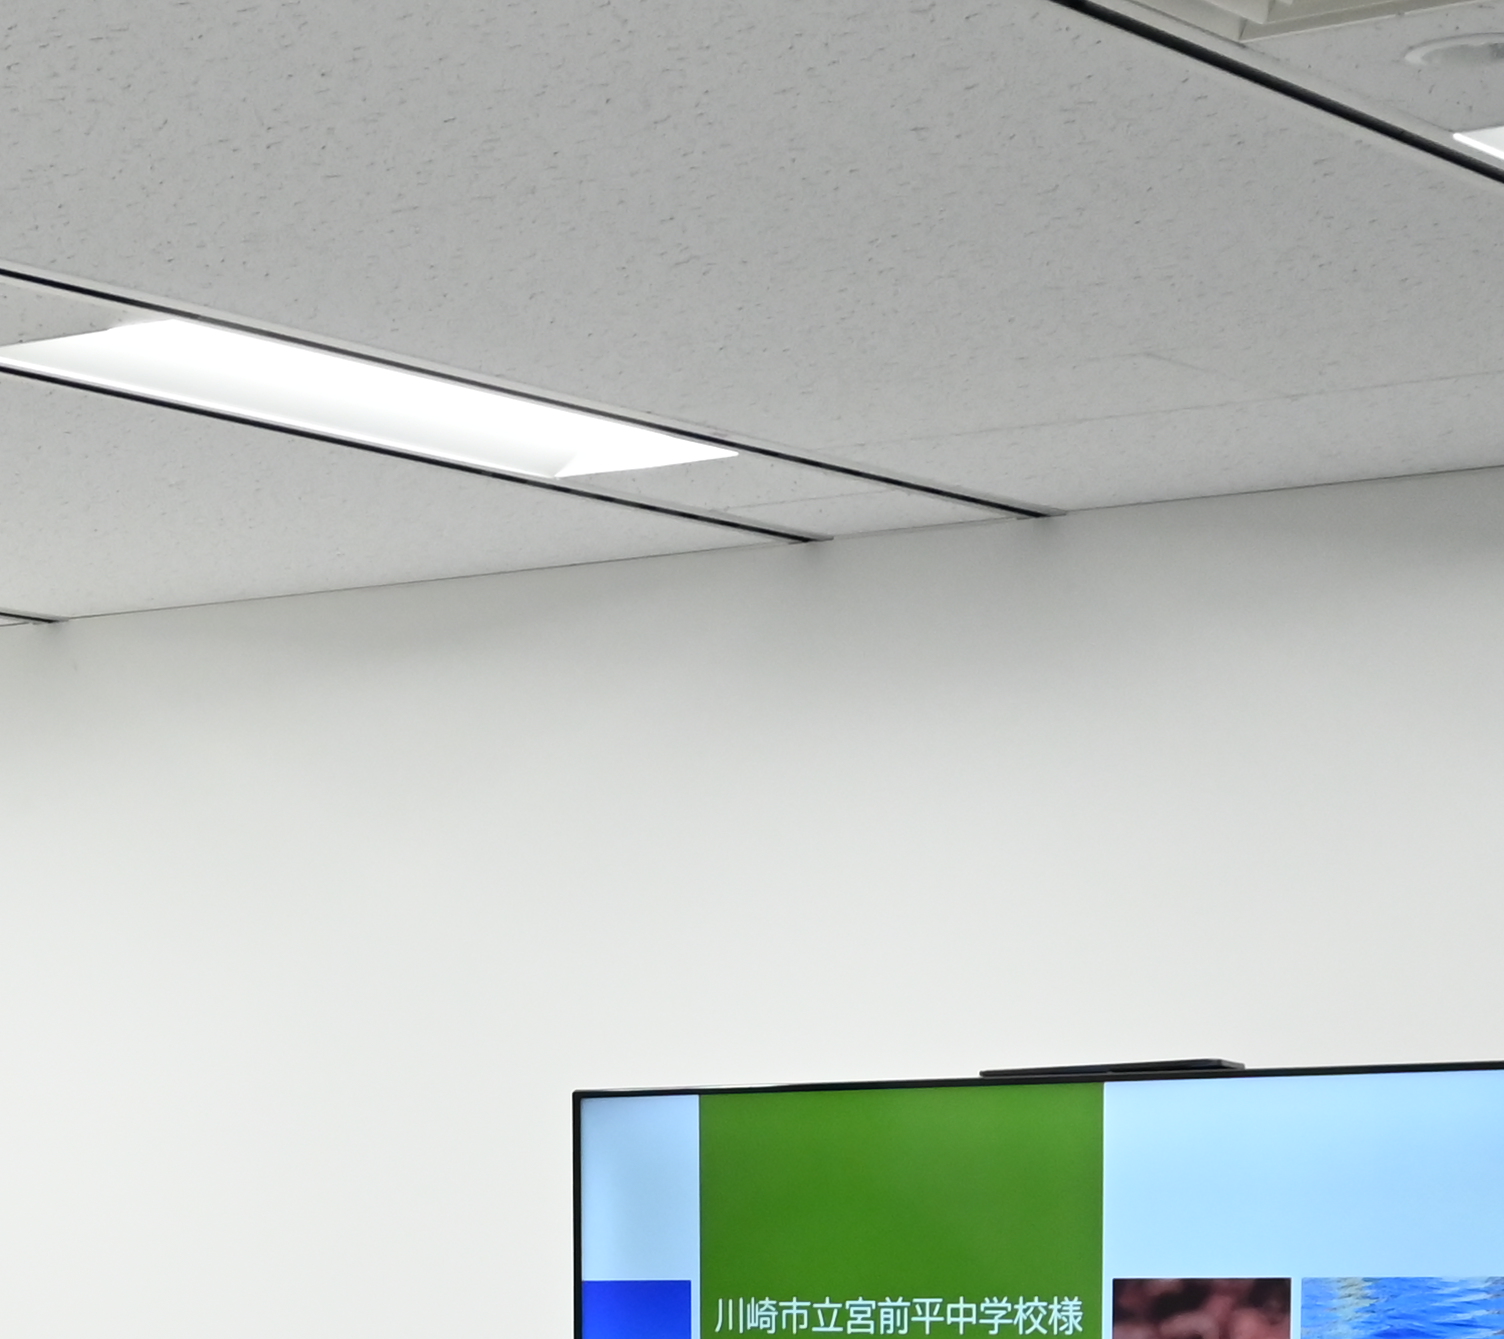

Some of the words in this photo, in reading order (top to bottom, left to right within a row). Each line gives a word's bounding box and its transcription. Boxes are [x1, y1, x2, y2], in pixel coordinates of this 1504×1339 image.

[715, 1296, 1084, 1335] 川崎市立宮前平中学校様
